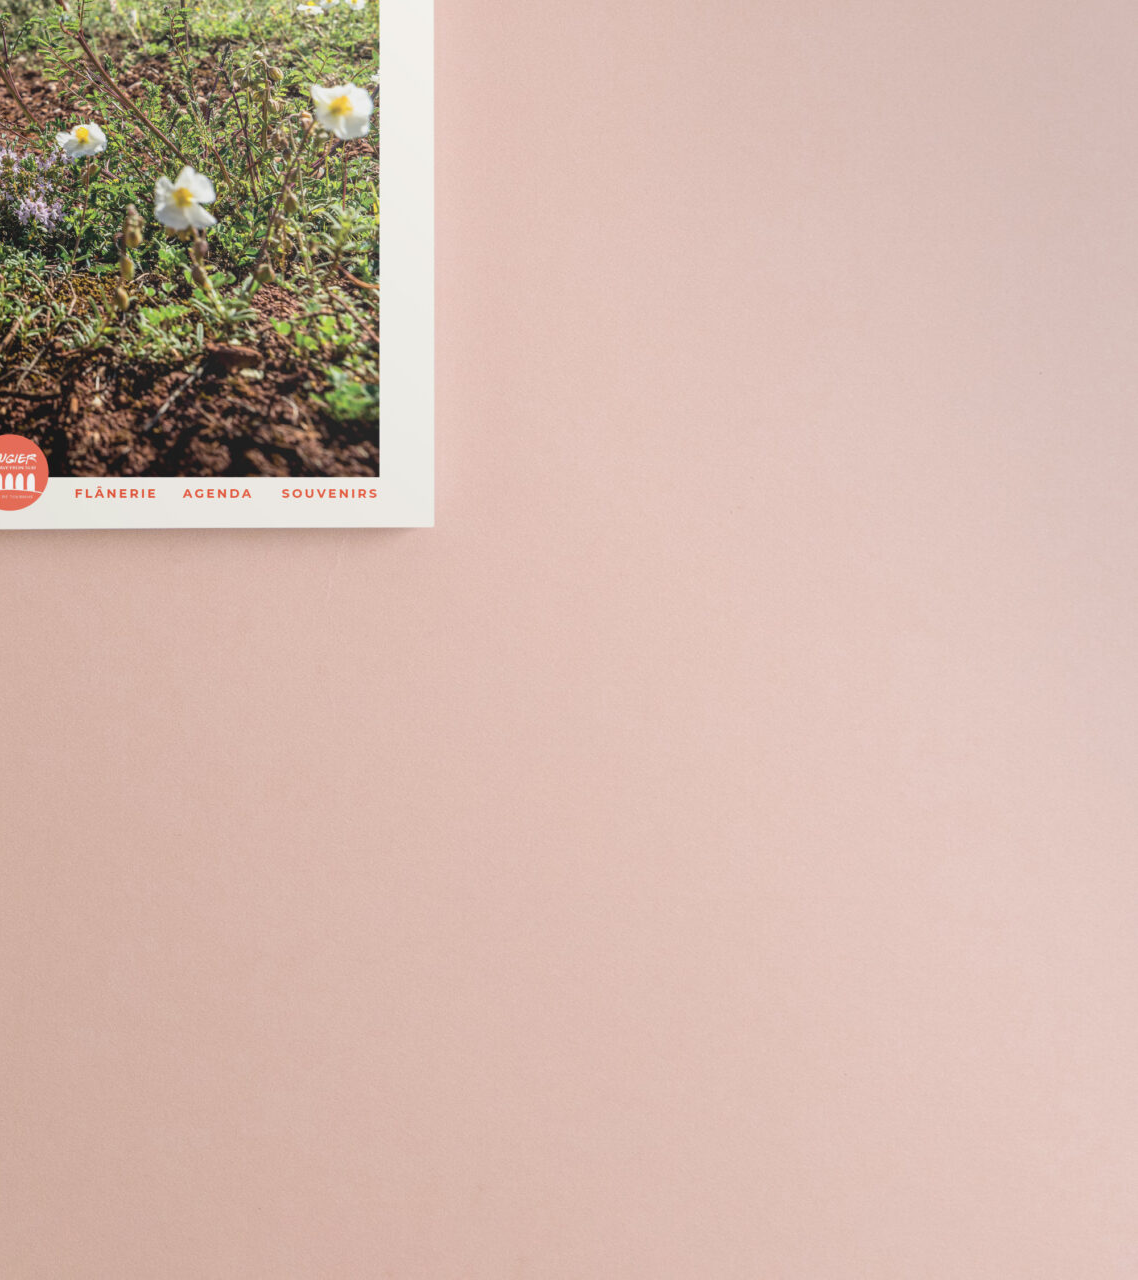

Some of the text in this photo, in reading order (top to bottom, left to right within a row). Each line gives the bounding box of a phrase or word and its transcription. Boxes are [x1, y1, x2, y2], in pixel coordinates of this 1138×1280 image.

[74, 485, 157, 499] FLÂNERIE
[182, 488, 252, 499] AGENDA
[281, 487, 378, 499] SOUVENIRS
